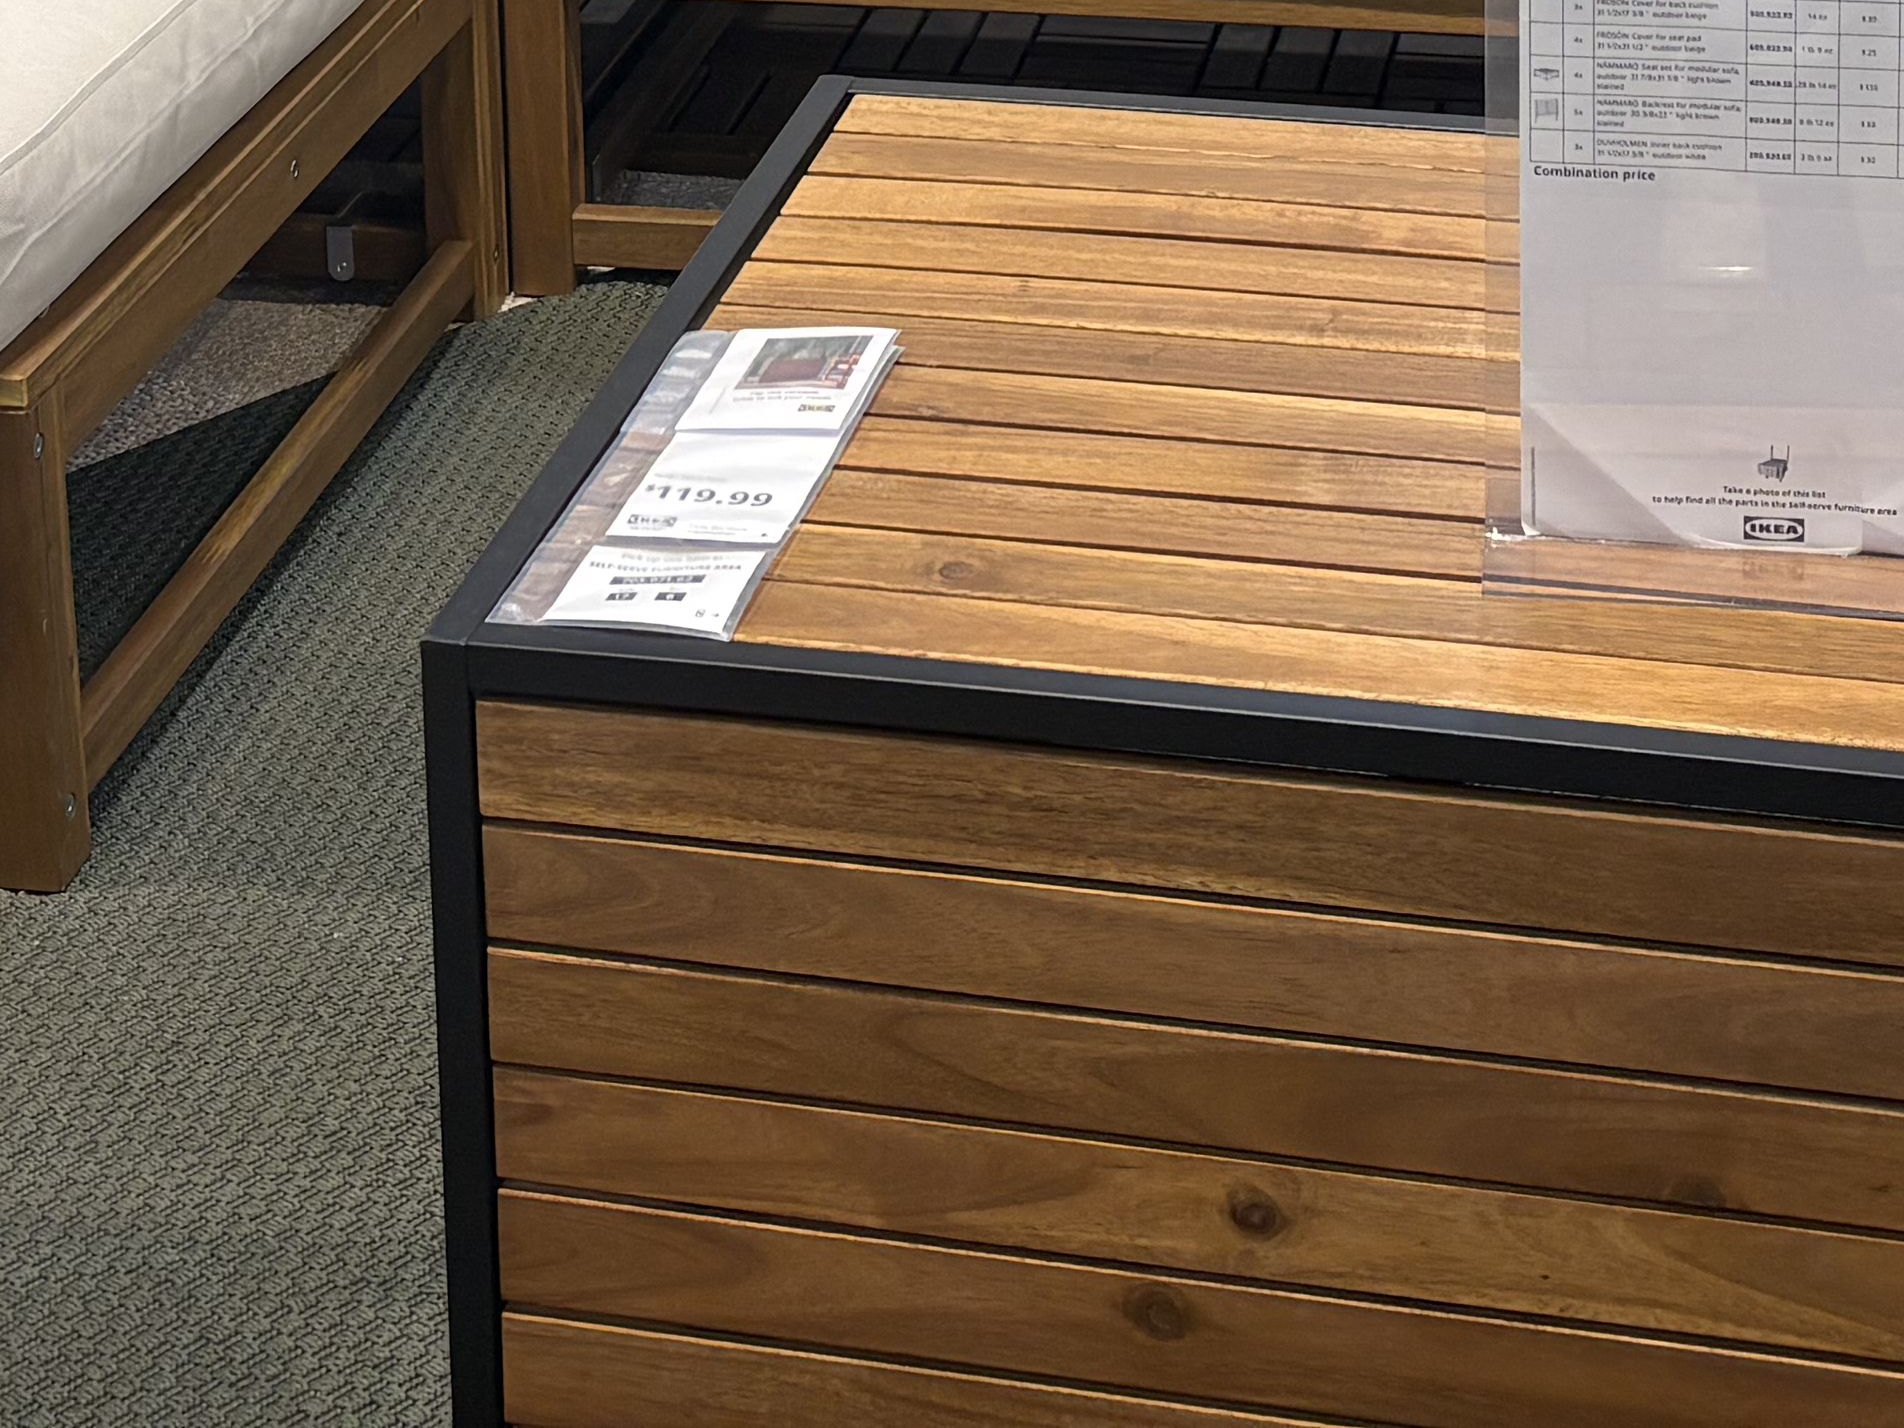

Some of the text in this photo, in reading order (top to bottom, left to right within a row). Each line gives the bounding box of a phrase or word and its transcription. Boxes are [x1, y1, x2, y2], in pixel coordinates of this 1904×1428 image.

[1534, 165, 1656, 182] Combination price
[645, 484, 773, 507] $119.99
[1723, 486, 1743, 494] Take
[1753, 488, 1780, 496] photo
[1664, 496, 1684, 505] help
[1685, 496, 1703, 504] find
[1834, 504, 1875, 514] furniture
[1749, 523, 1799, 535] IKEA
